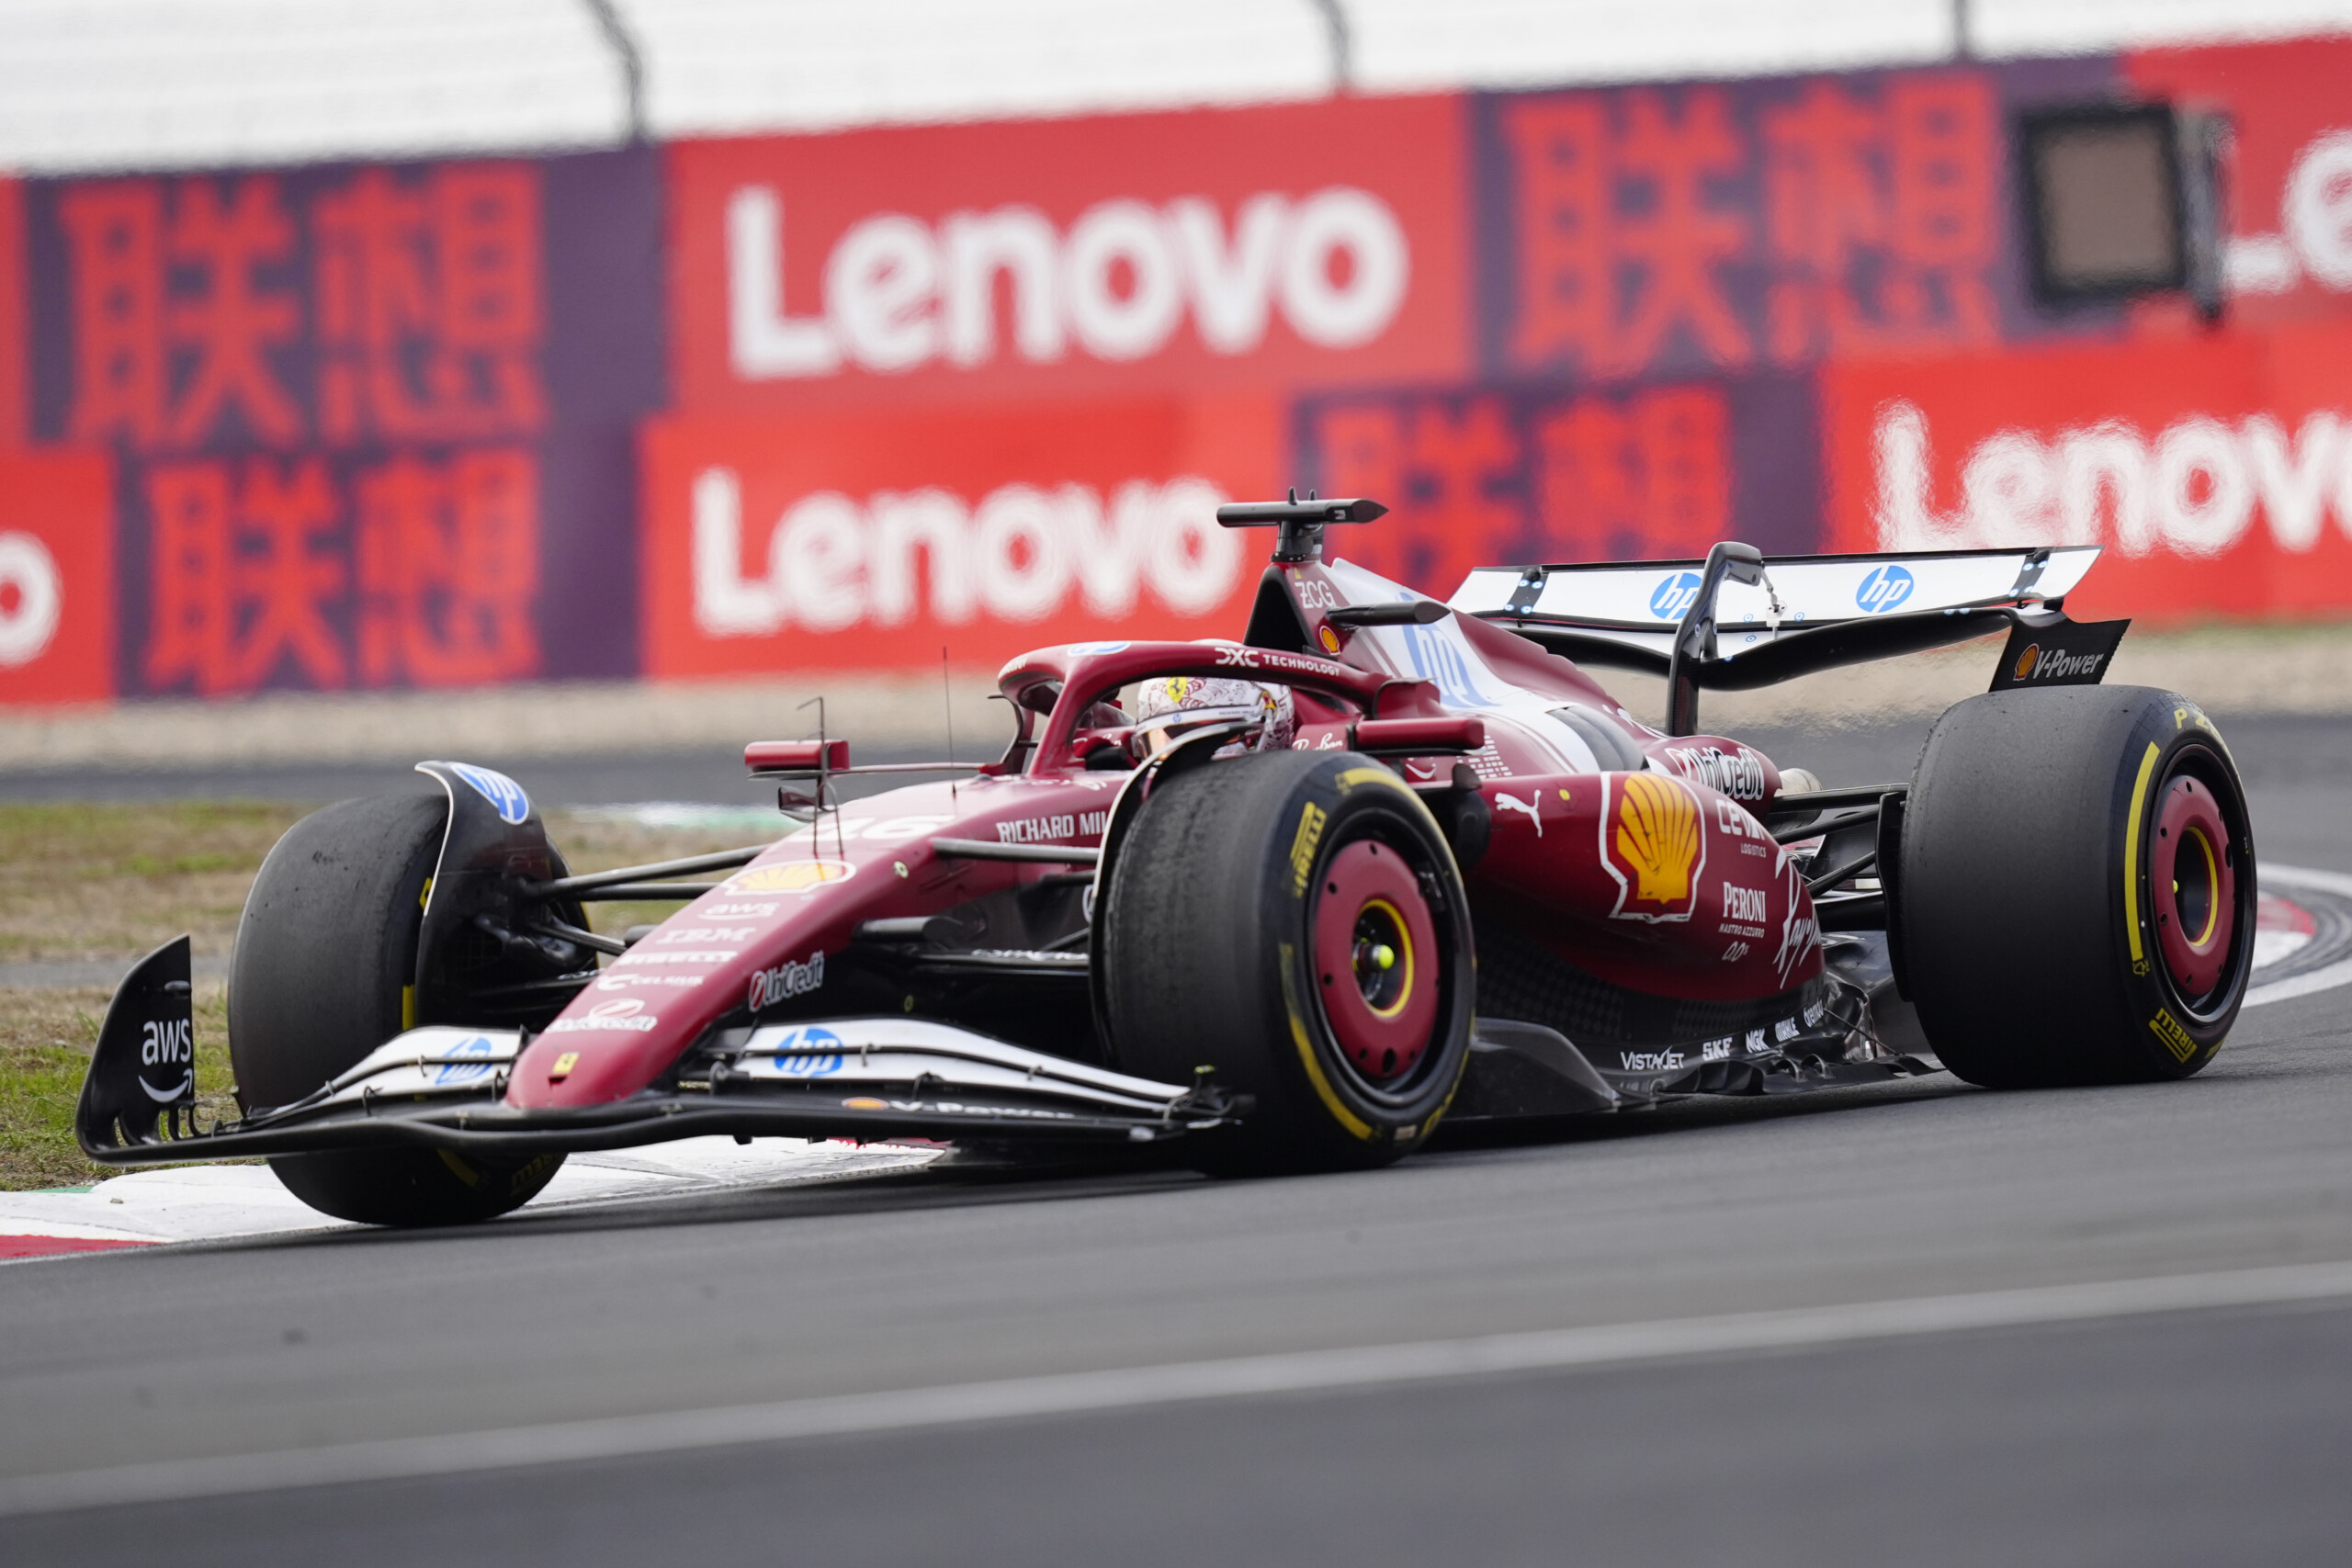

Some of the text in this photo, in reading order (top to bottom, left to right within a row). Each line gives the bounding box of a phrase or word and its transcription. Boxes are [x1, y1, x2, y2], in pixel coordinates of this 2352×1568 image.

[1501, 73, 1998, 371] 联想
[59, 162, 544, 450] 联想
[728, 186, 1408, 378] Lenovo
[1871, 397, 2352, 562] Lenov
[143, 446, 544, 700] 联想
[692, 467, 1245, 636] Lenovo
[1295, 581, 1335, 609] ZCG
[1857, 565, 1914, 613] hp
[1215, 647, 1340, 676] DXC TECHNOLOGY
[2033, 649, 2104, 679] V-Power
[1689, 746, 1765, 801] UniCredit
[996, 811, 1107, 843] RICHARD MIL
[1740, 843, 1767, 858] LOGISTICS
[1723, 882, 1766, 922] PERONI
[141, 1018, 191, 1066] aws
[775, 1027, 843, 1077] hp
[1702, 1036, 1733, 1062] SKF
[1746, 1028, 1770, 1054] NGK
[2149, 1008, 2198, 1064] PIRELLI
